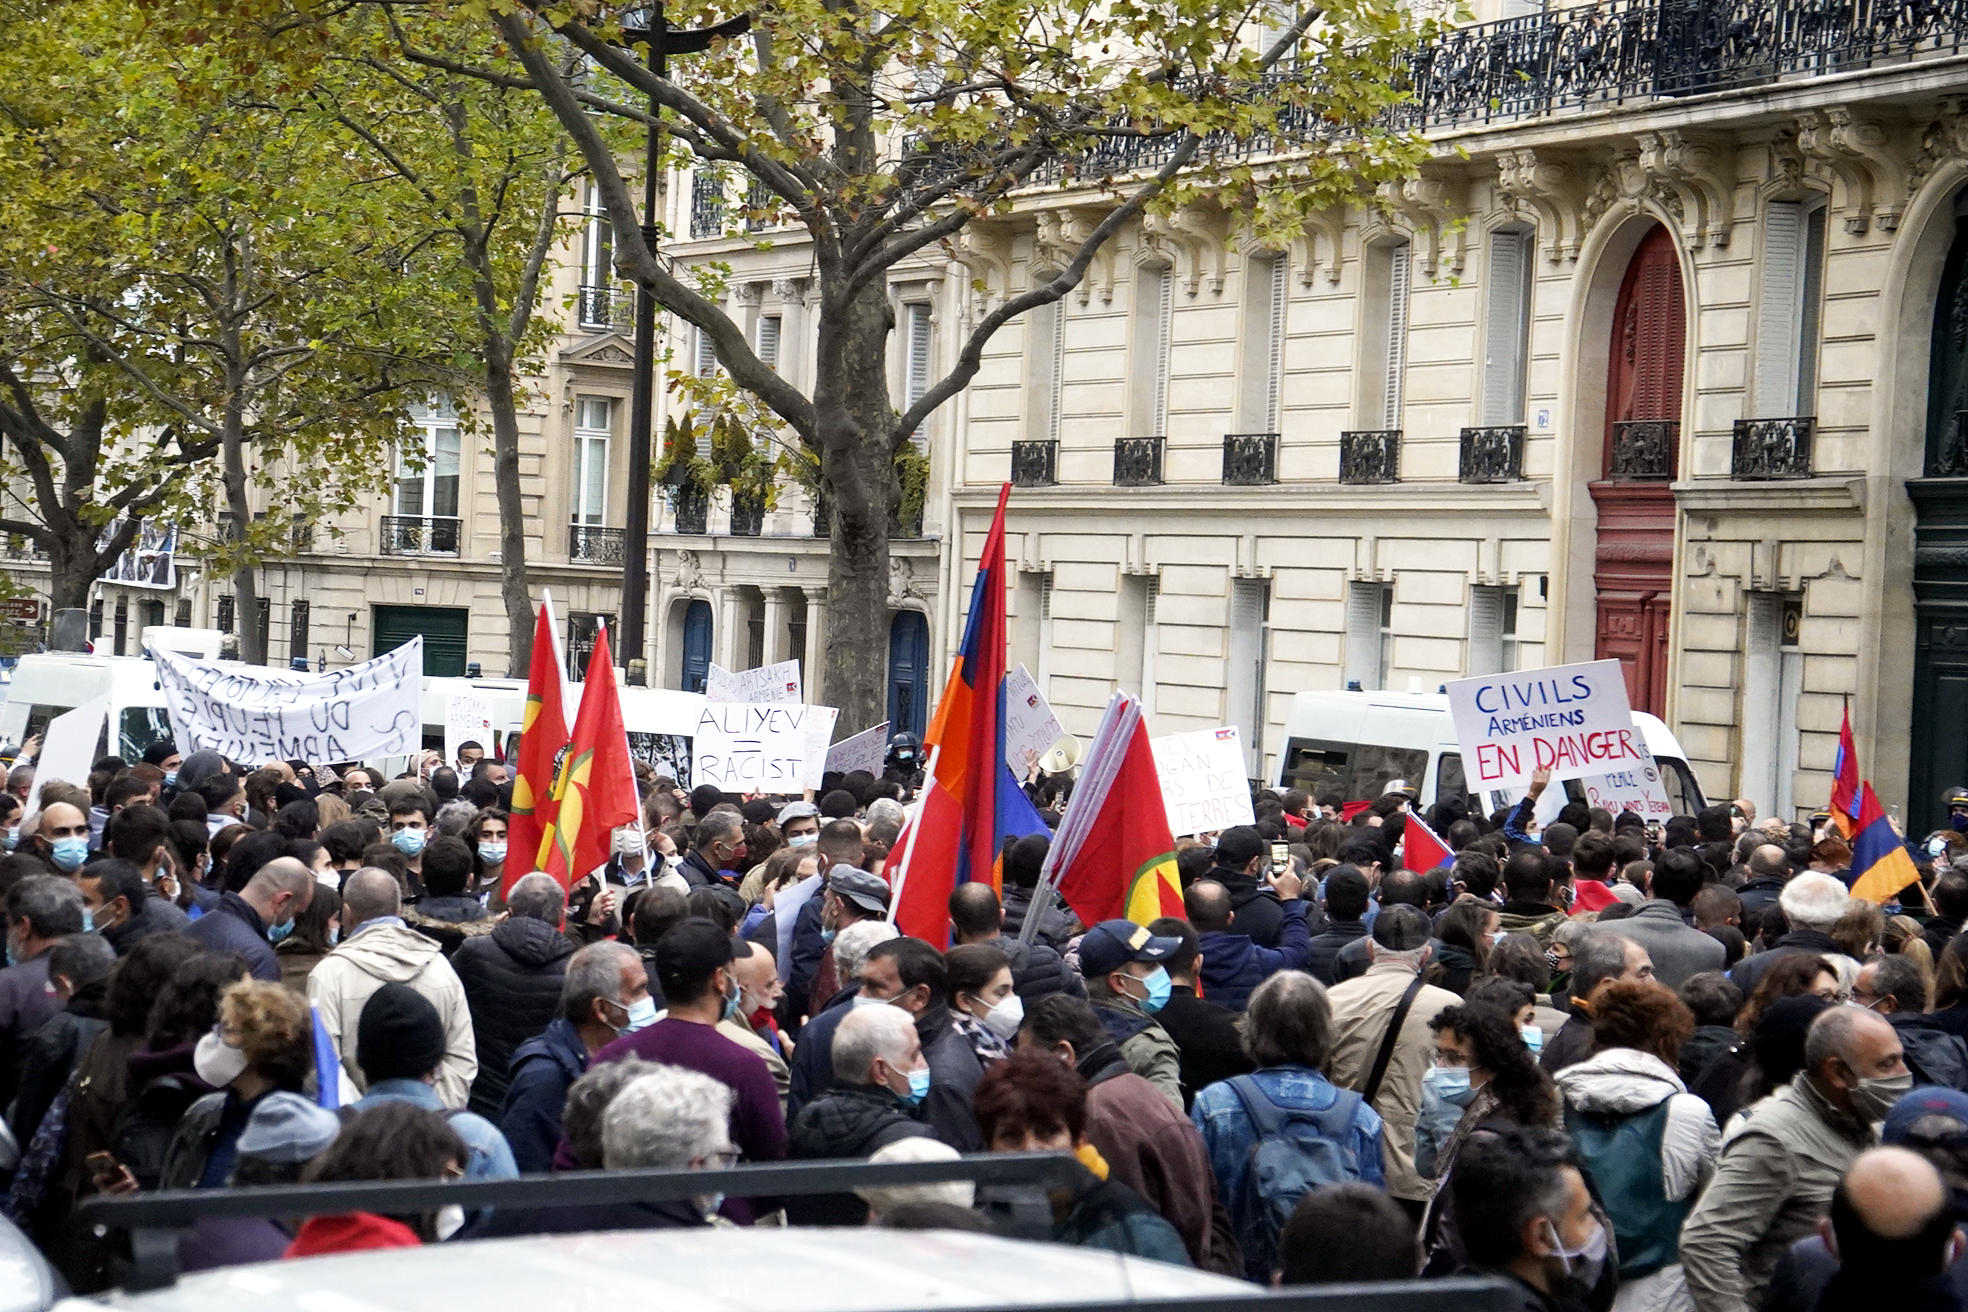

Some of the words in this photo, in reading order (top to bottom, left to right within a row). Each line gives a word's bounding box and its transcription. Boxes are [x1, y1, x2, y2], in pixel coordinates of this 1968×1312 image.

[1476, 675, 1592, 714] CIVILS
[1488, 709, 1585, 738] ARMÉNIENS
[1476, 743, 1521, 781] EN
[1533, 729, 1641, 772] DANGER
[1207, 770, 1236, 793] DE
[1175, 793, 1252, 831] TERRES
